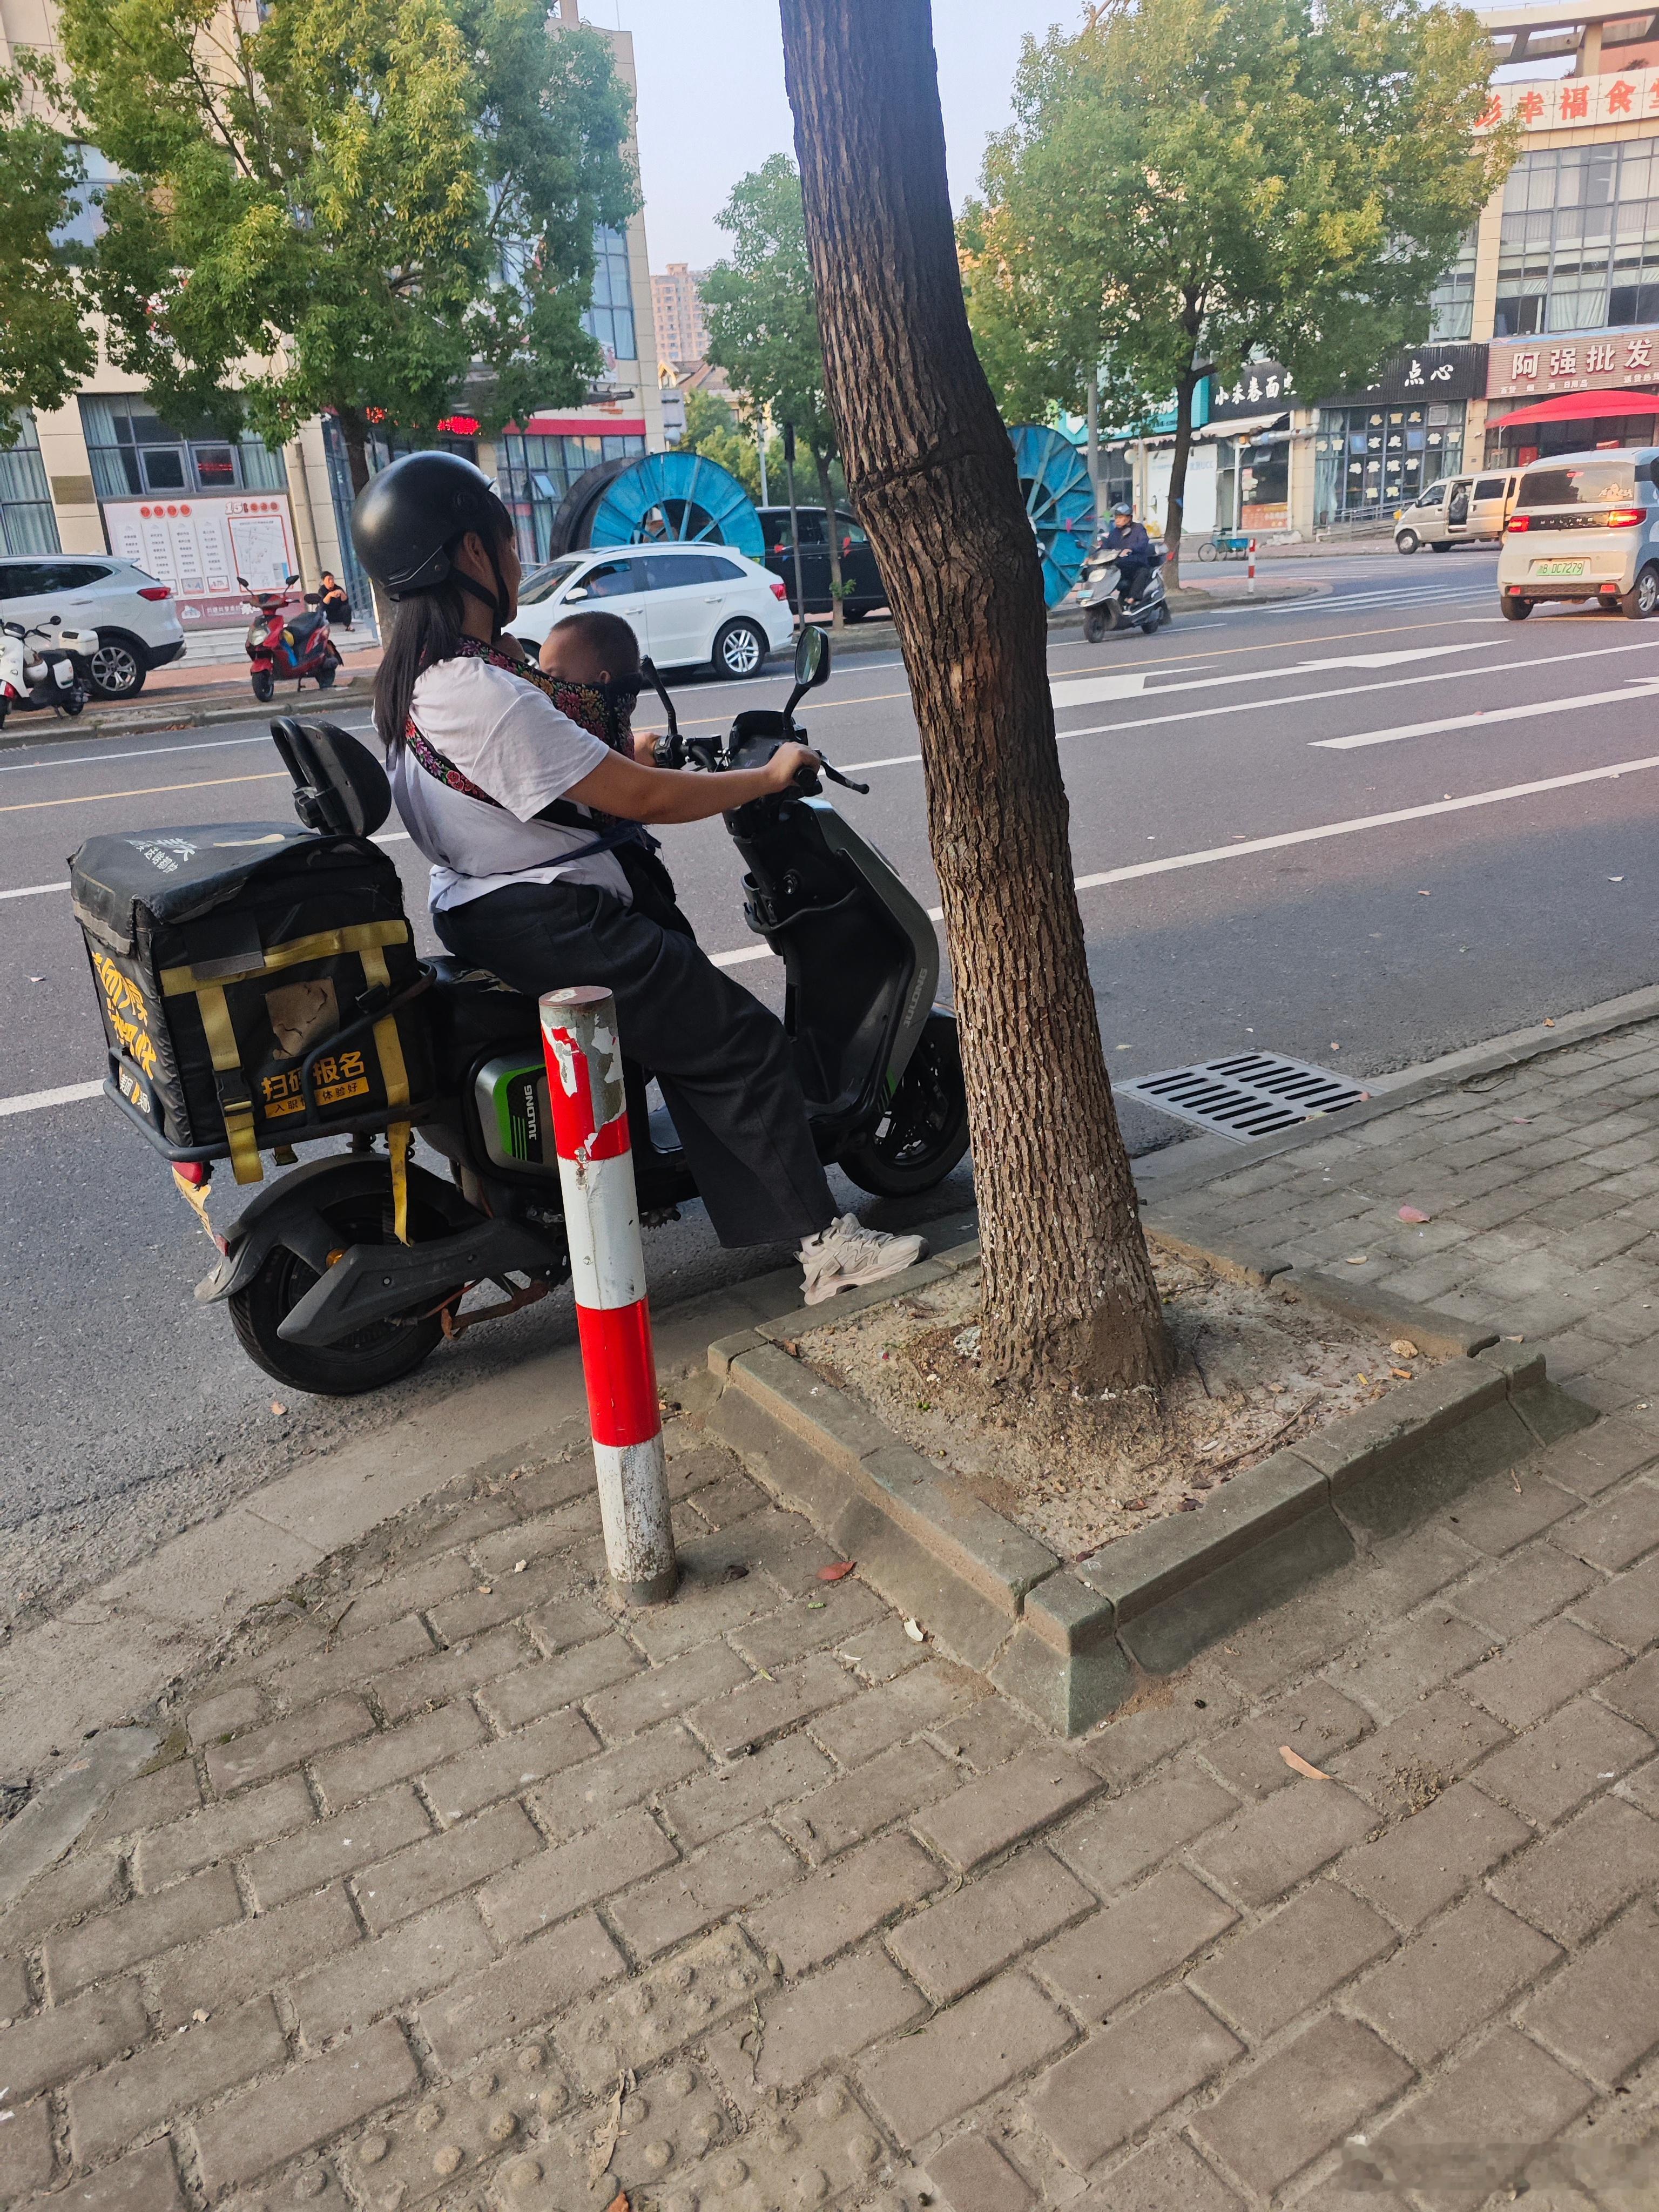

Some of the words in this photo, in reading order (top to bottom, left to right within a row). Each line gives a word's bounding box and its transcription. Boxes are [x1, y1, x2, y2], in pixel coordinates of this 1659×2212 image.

[1405, 360, 1454, 387] 点心
[1512, 339, 1653, 380] 阿强批发
[1563, 380, 1588, 389] 日用品
[1551, 563, 1582, 573] DC7279
[903, 967, 928, 1029] JULONG
[262, 1050, 365, 1102] 扫码报名
[322, 1082, 358, 1102] 体验好
[523, 1084, 537, 1141] JULONG
